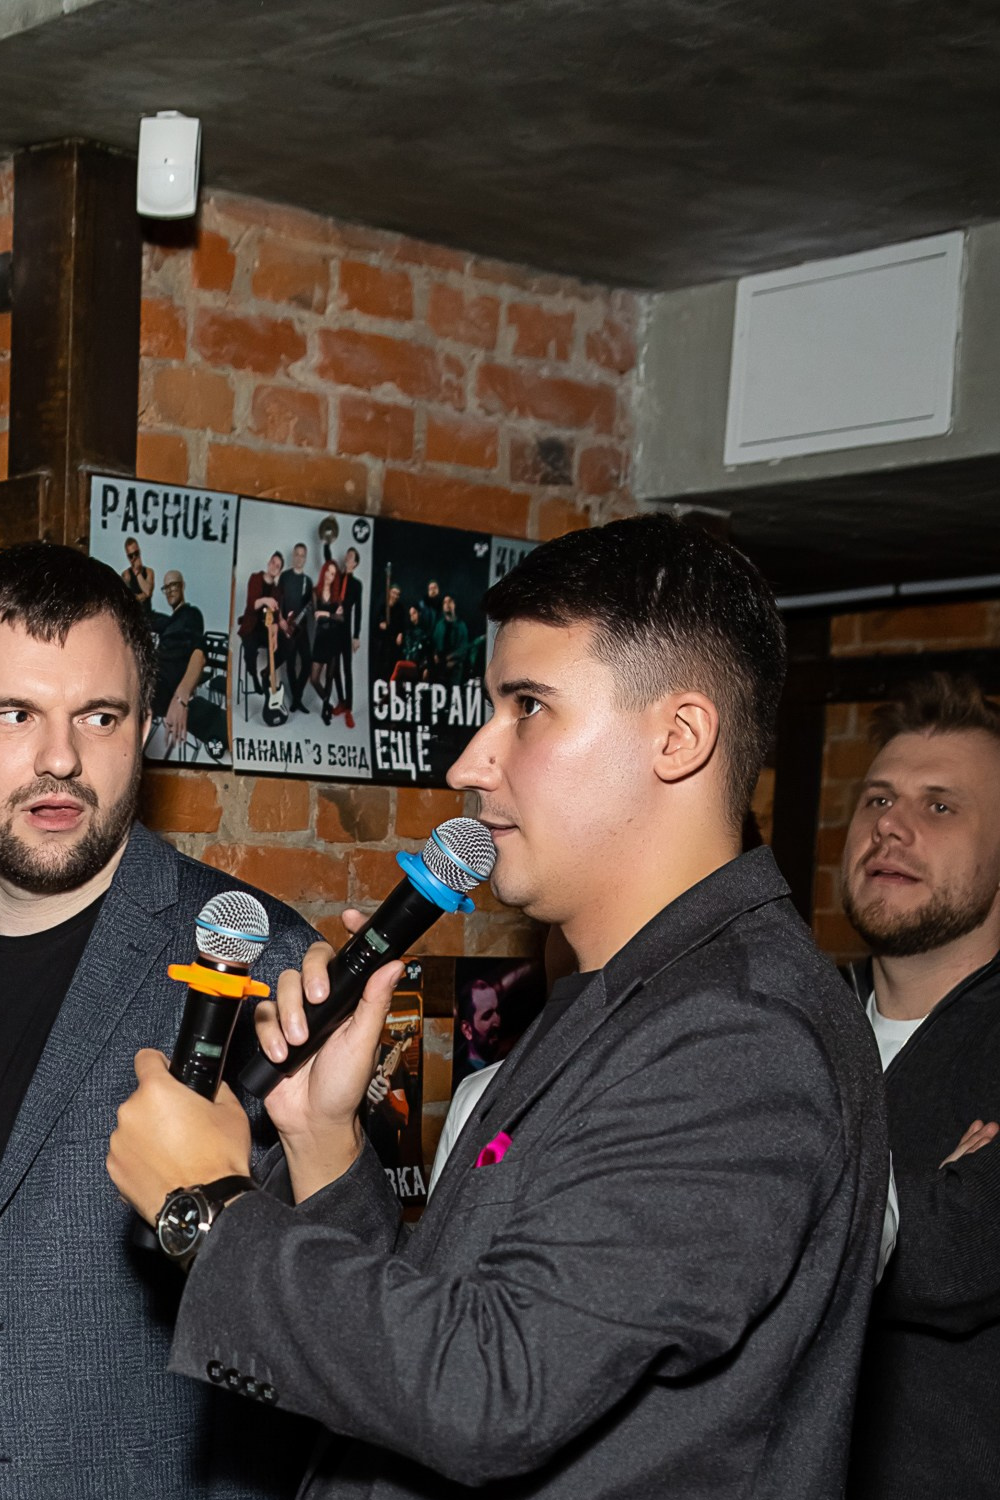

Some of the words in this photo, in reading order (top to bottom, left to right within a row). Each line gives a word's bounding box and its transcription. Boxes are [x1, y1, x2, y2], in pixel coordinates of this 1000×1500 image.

[101, 484, 230, 543] PACHULI
[373, 678, 482, 727] СЫГРАЙ
[374, 725, 432, 781] ЕЩЁ
